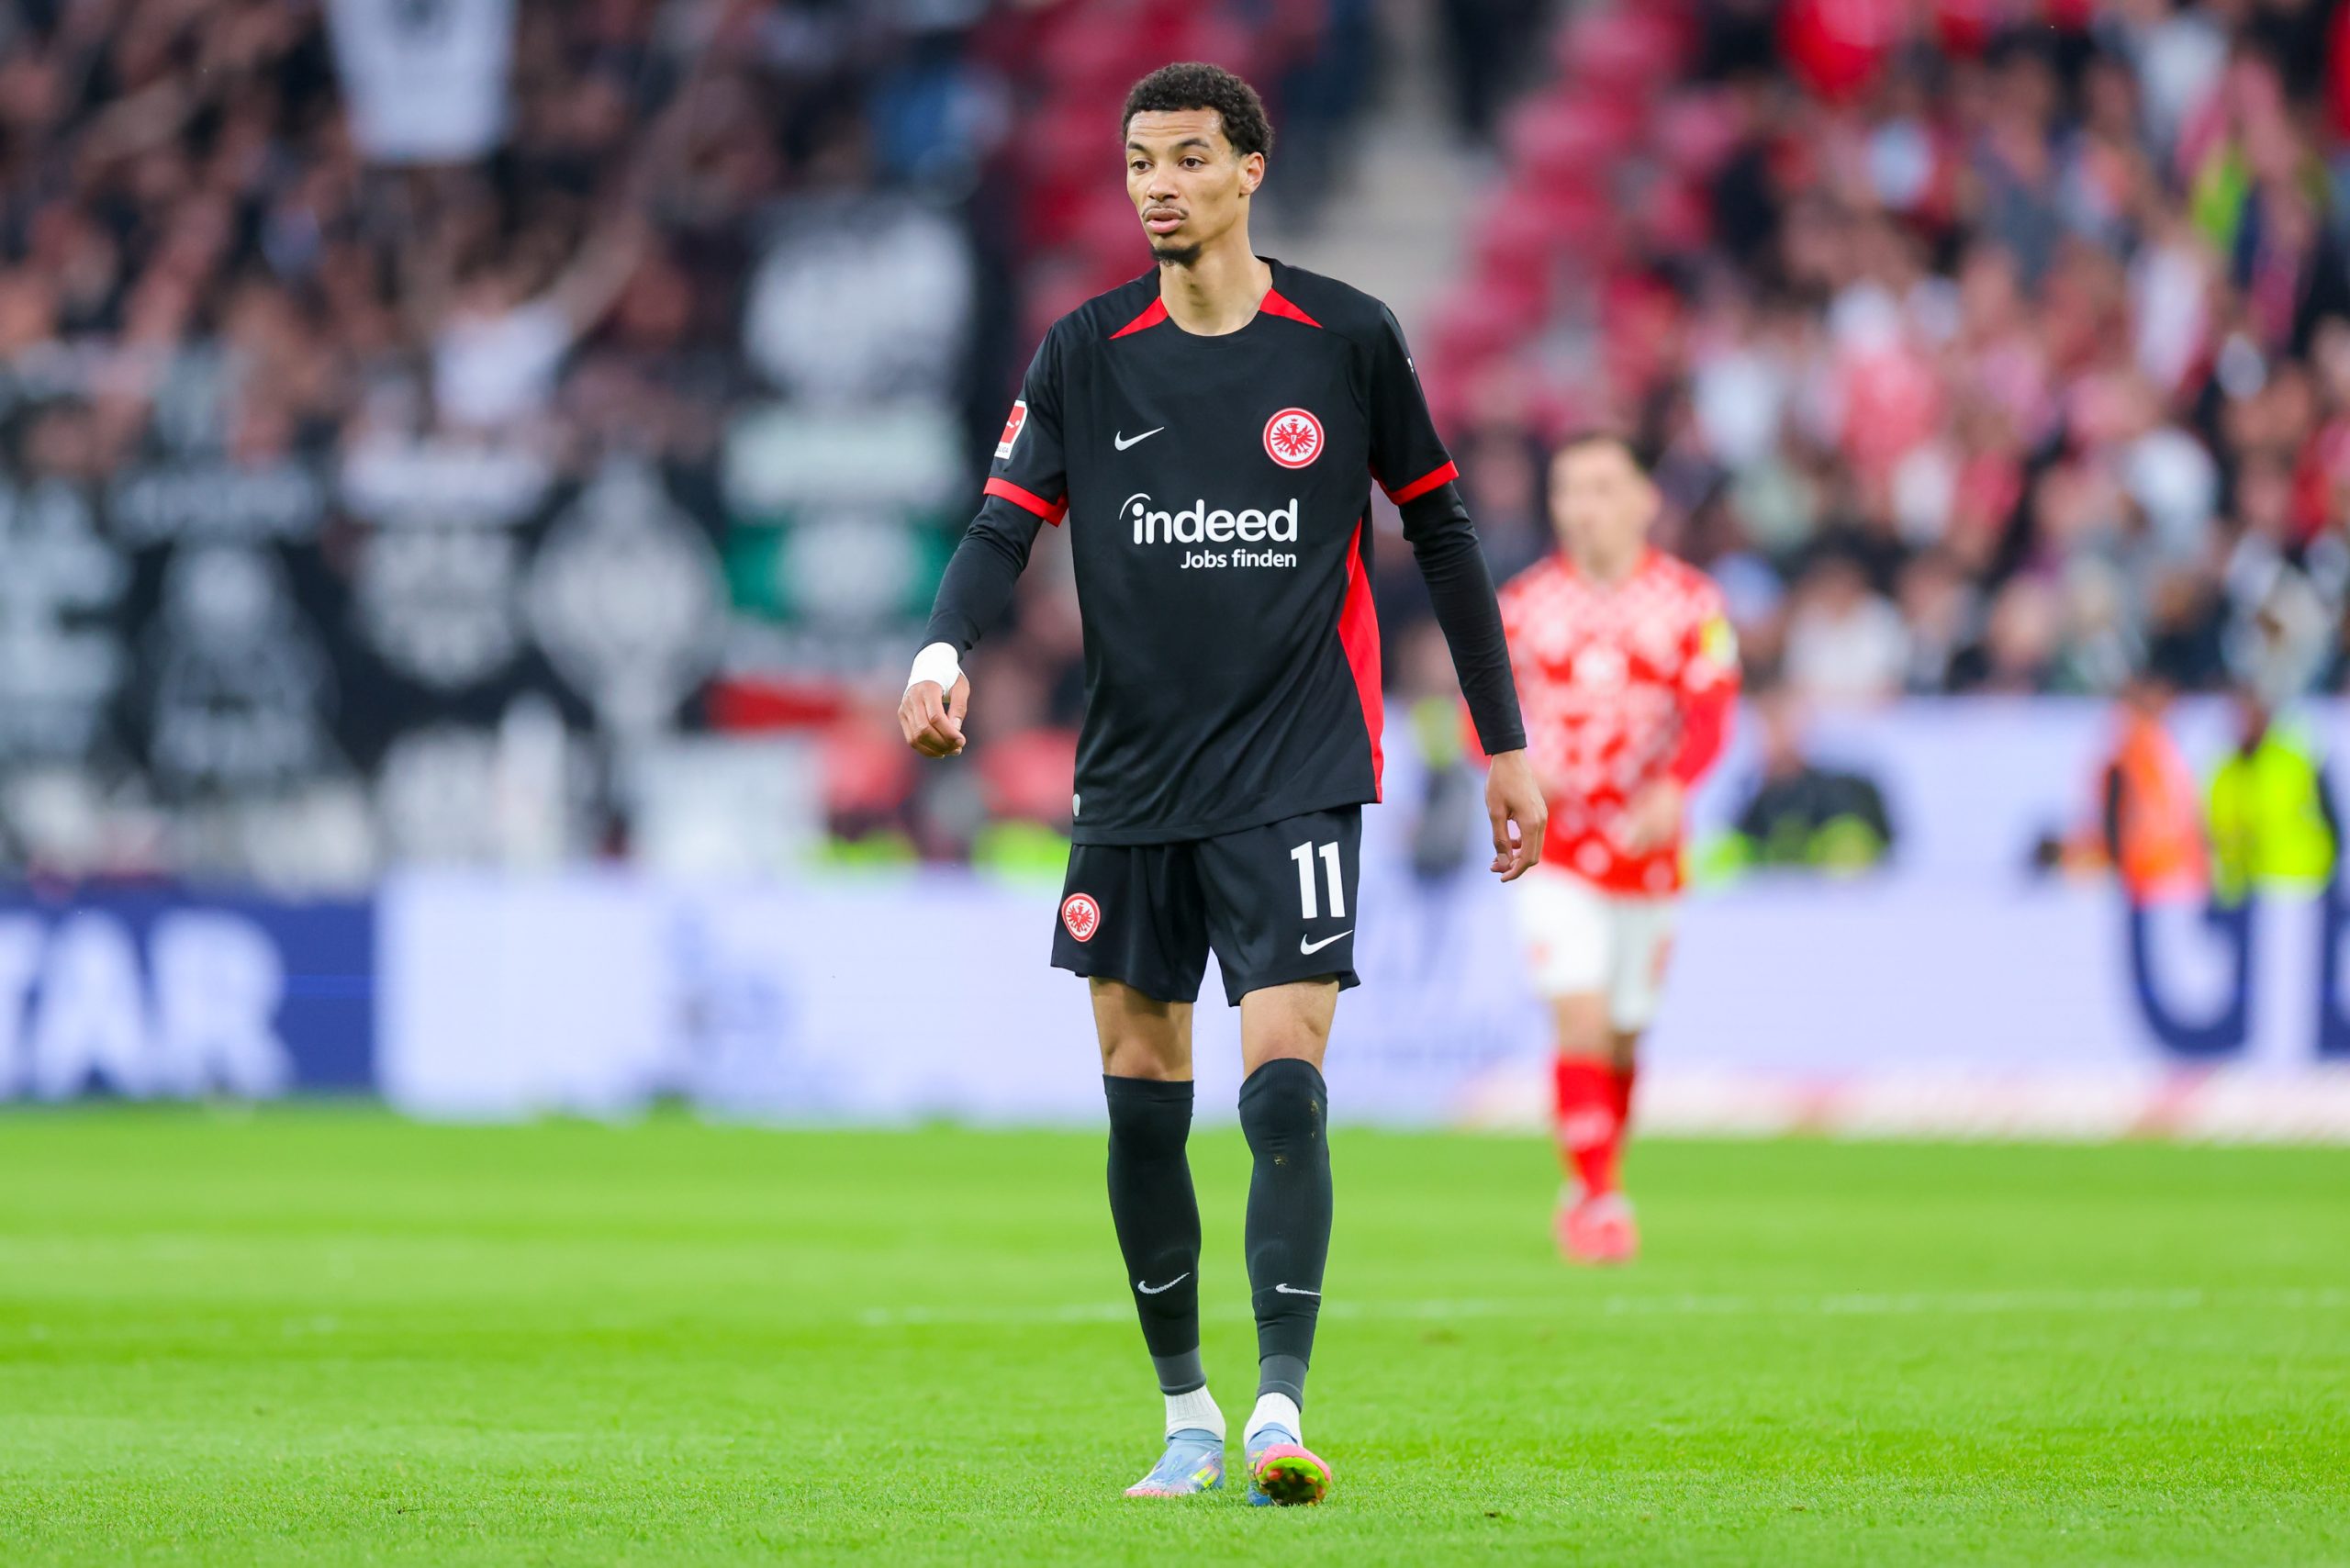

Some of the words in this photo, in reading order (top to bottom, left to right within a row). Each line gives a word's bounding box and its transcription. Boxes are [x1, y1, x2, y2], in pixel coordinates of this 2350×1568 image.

[1128, 497, 1298, 545] indeed
[1180, 549, 1227, 569] Jobs
[1231, 548, 1297, 568] finden
[1290, 840, 1346, 919] 11
